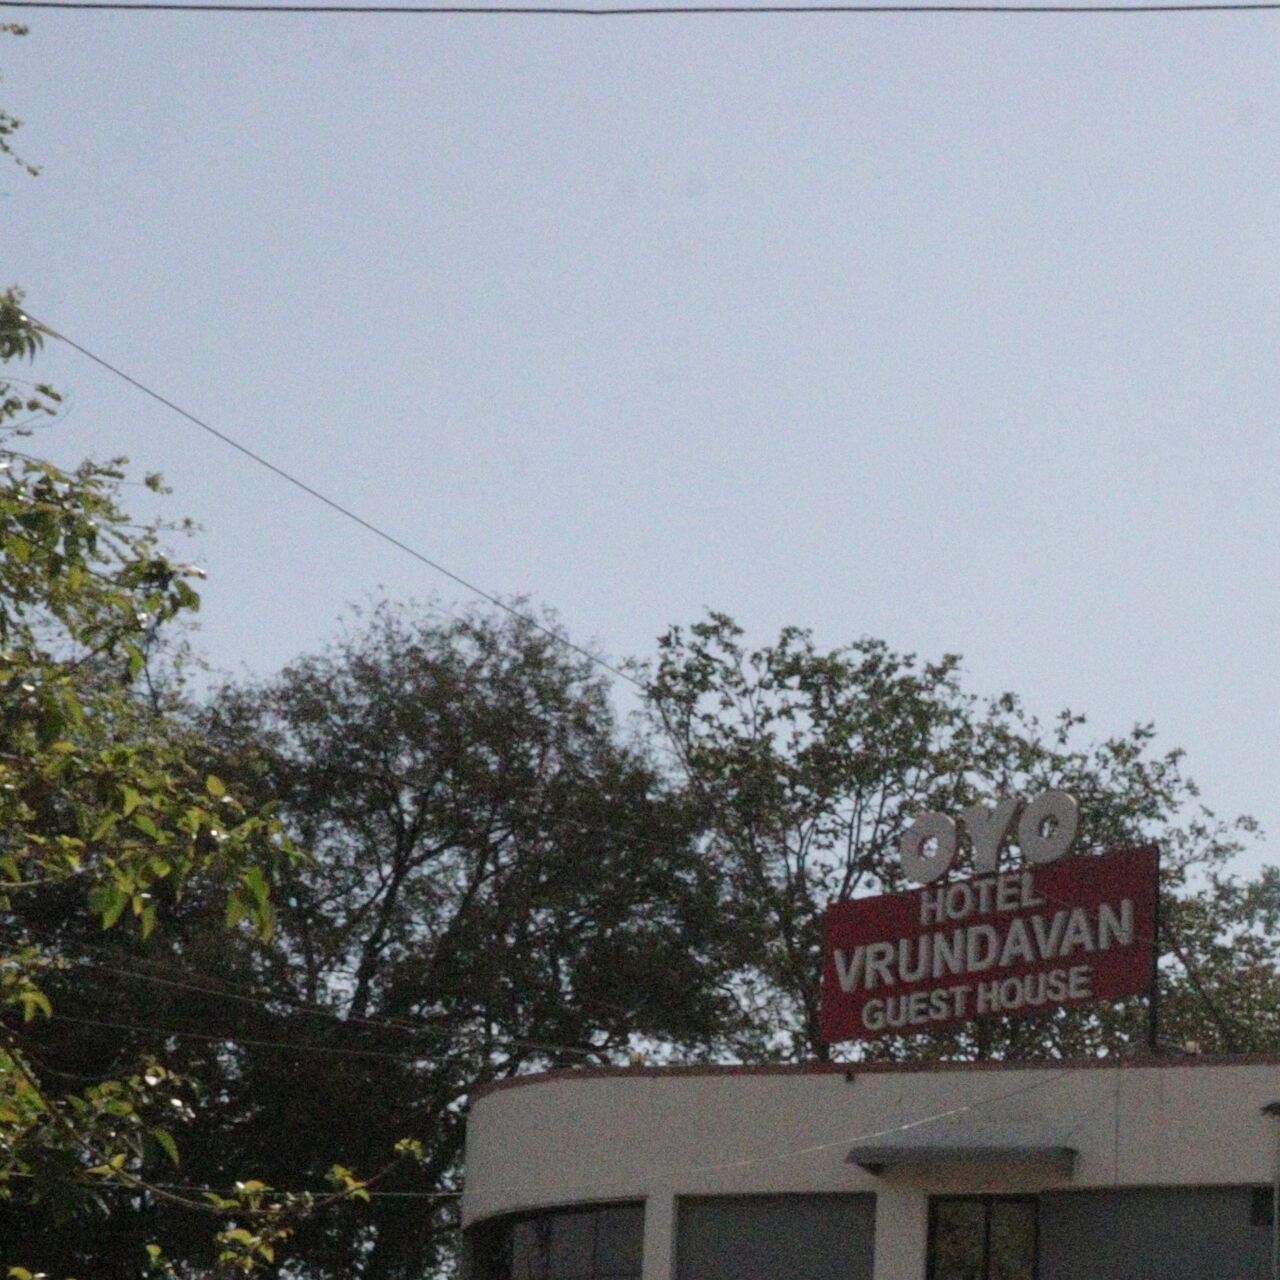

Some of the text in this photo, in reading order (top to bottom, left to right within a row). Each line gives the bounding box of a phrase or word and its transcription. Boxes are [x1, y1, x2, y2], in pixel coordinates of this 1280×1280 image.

[900, 790, 1079, 884] OYO
[920, 872, 1047, 926] HOTEL
[833, 898, 1136, 994] VRUNDAVAN
[861, 965, 1095, 1031] GUEST HOUSE
